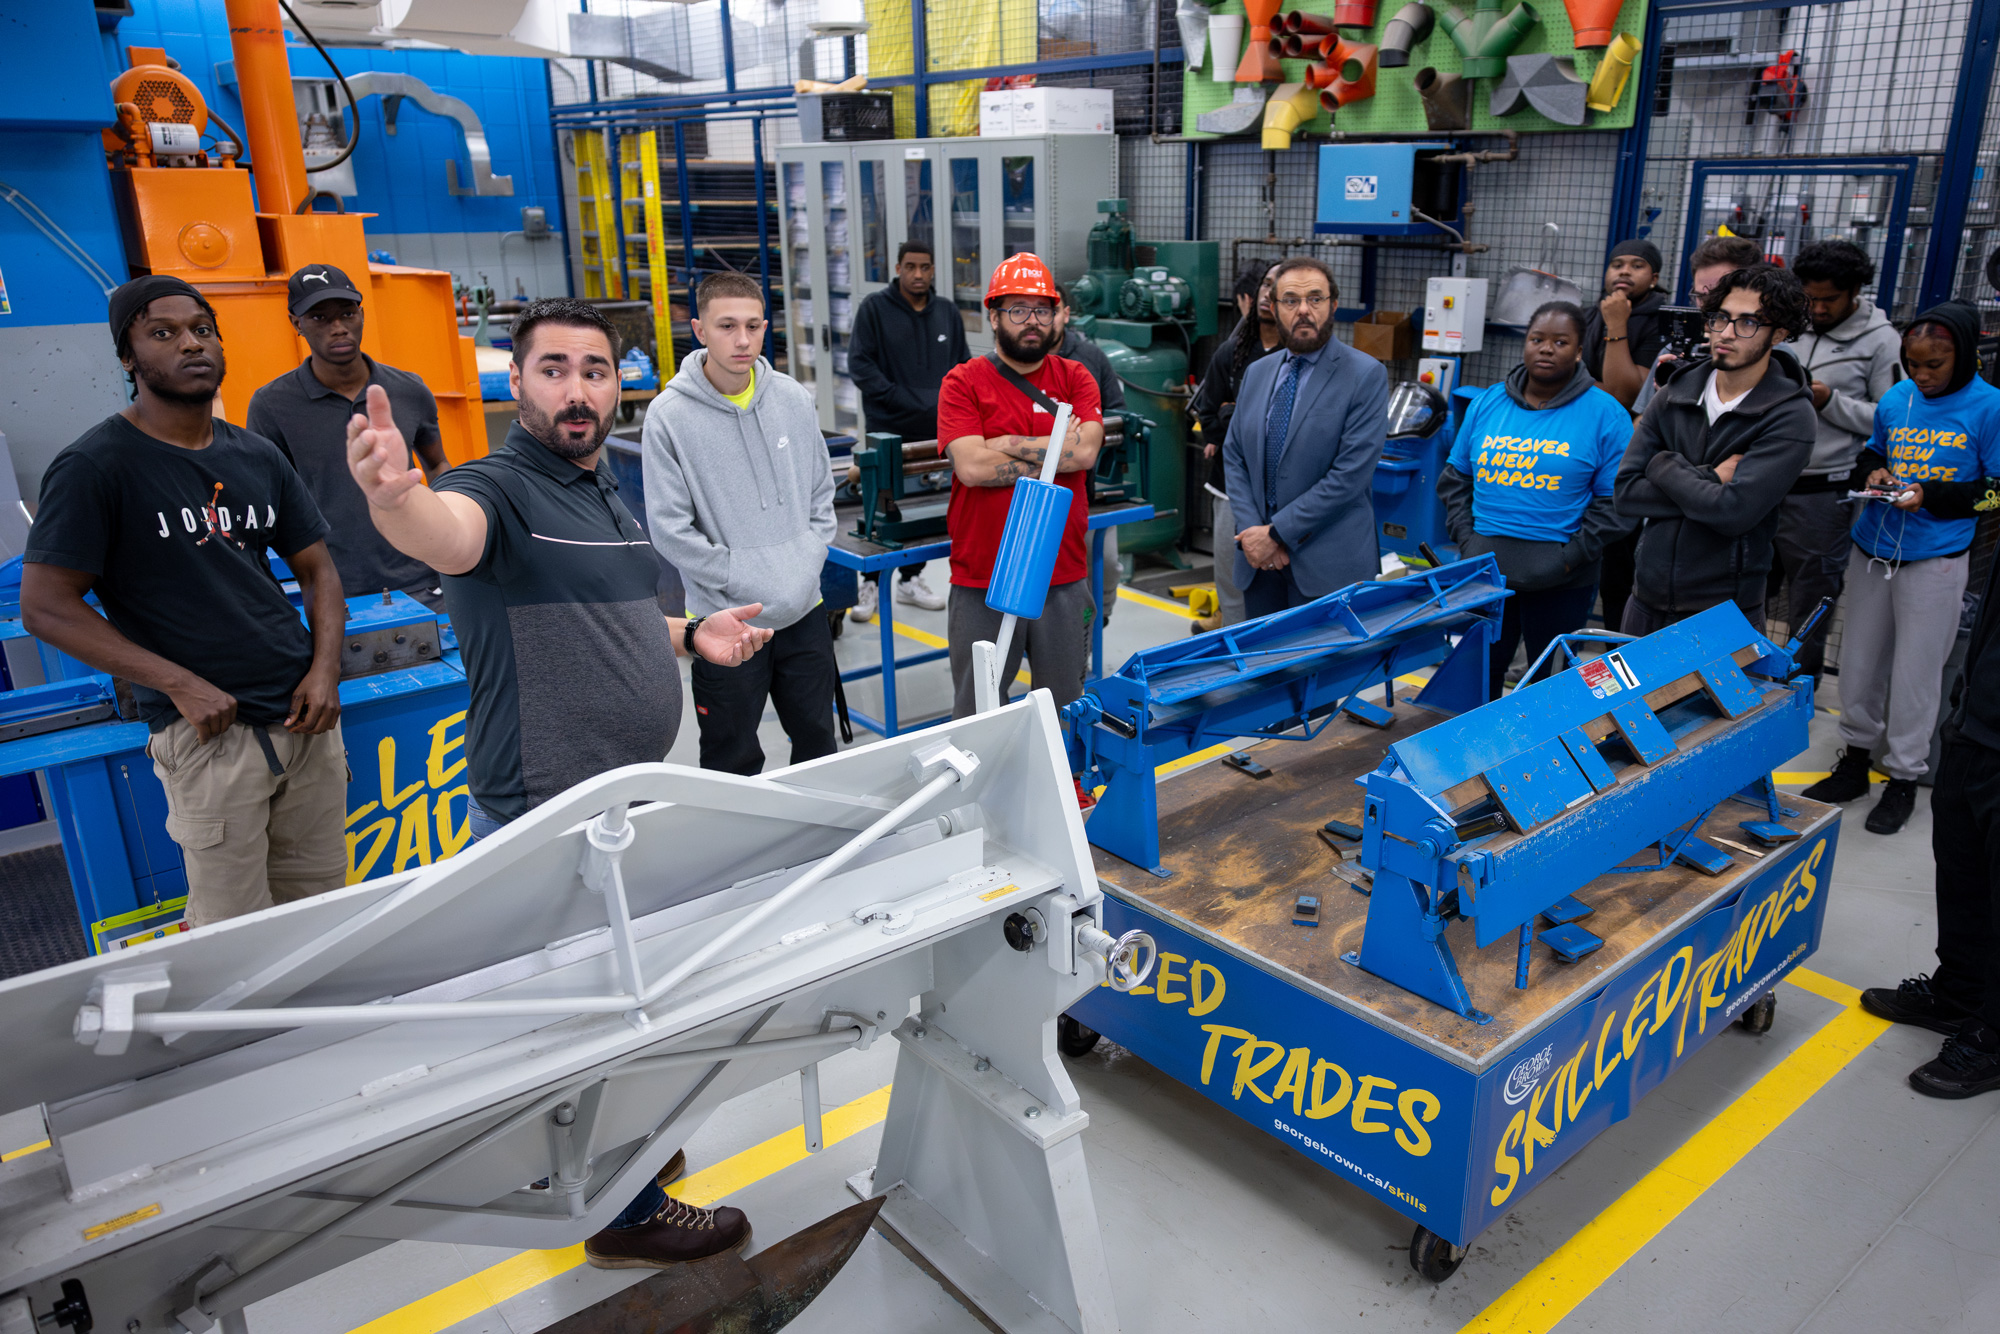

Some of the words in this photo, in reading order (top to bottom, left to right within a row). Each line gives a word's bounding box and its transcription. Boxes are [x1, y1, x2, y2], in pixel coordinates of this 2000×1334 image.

[1476, 450, 1489, 466] A
[1490, 451, 1539, 470] NEW
[1481, 435, 1570, 457] DISCOVER
[1891, 444, 1936, 462] NEW
[1476, 467, 1563, 490] PURPOSE
[1725, 942, 1808, 1018] georgebrown.ca/skills
[1490, 945, 1694, 1208] SKILLED
[1676, 838, 1827, 1058] TRADES
[1512, 1042, 1554, 1081] GEORGE
[1514, 1052, 1553, 1090] BROWN
[1200, 1023, 1442, 1158] TRADES
[1274, 1118, 1428, 1213] georgebrown.ca/skills
